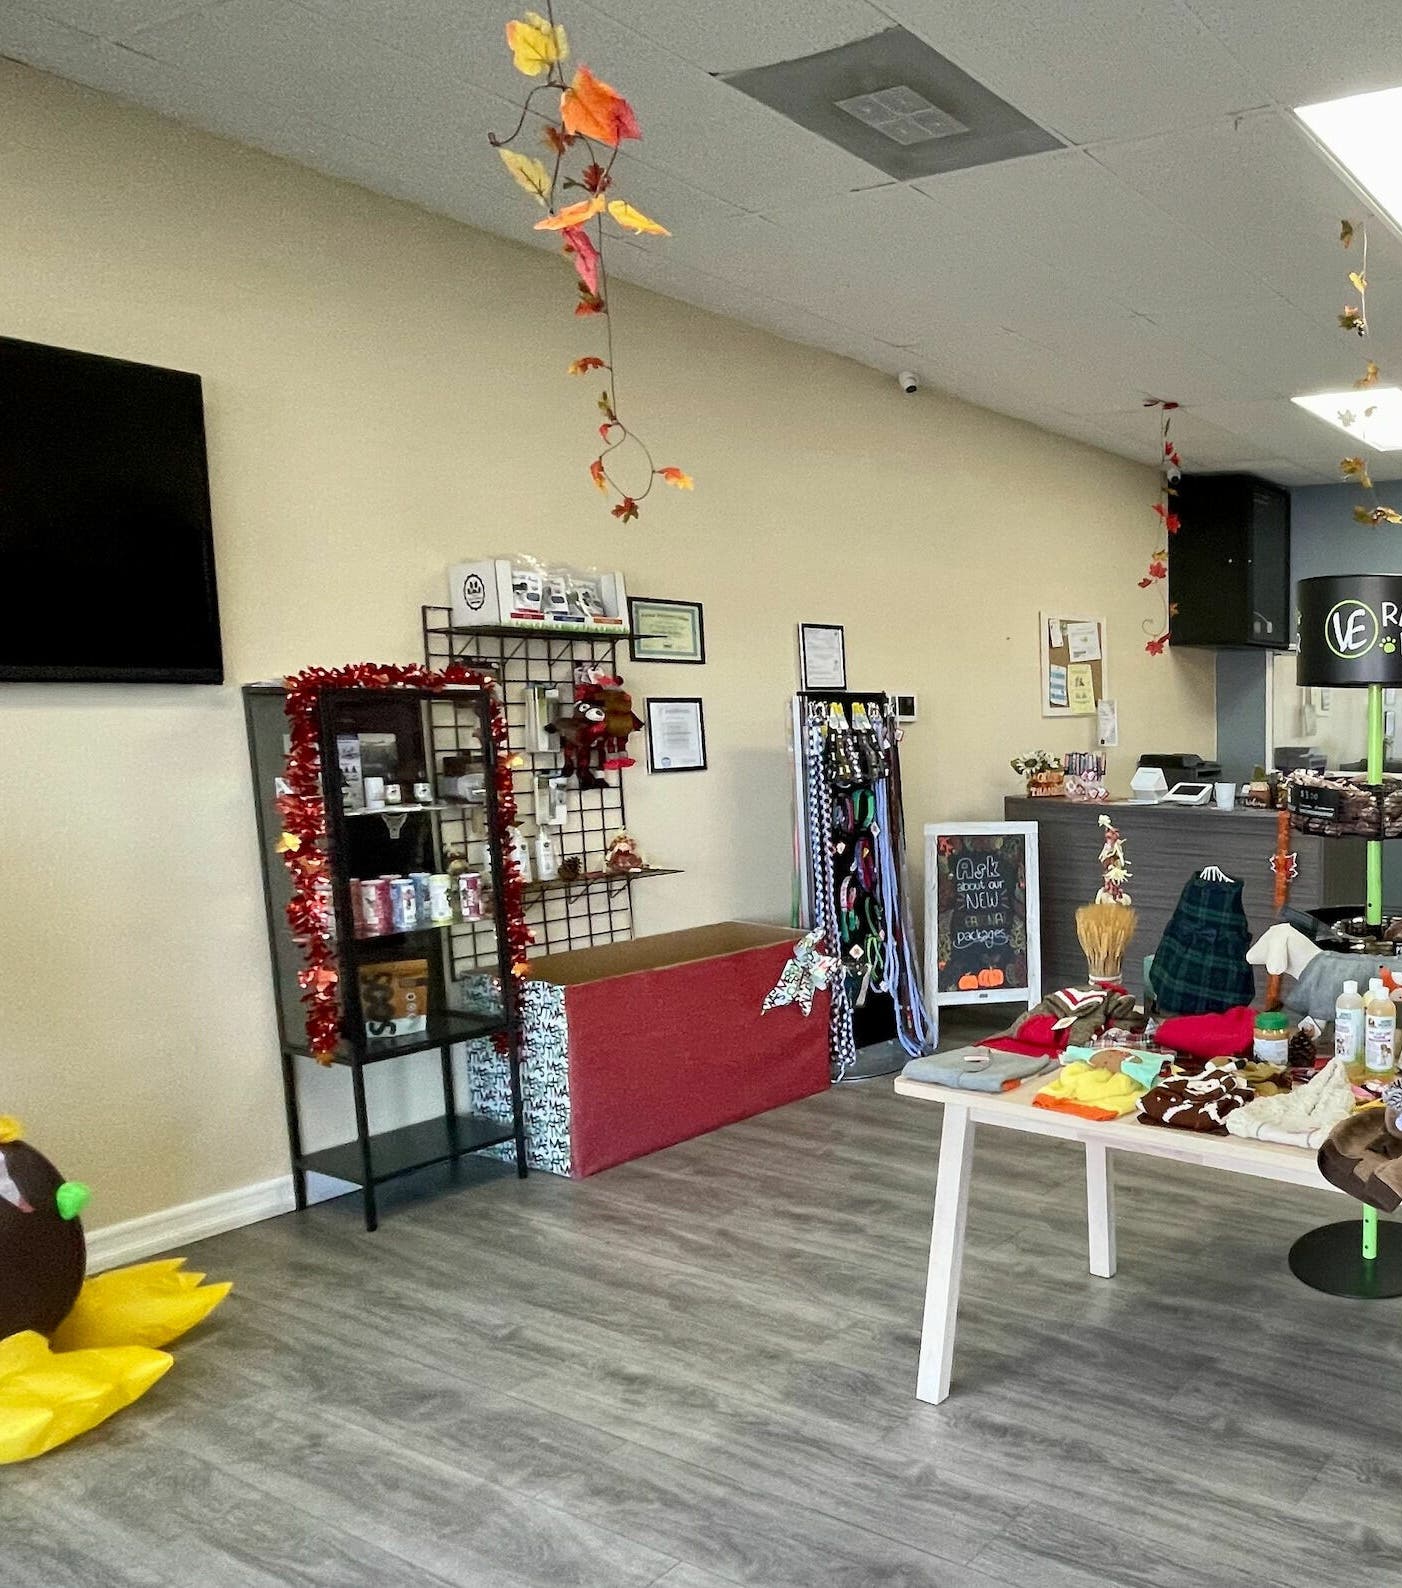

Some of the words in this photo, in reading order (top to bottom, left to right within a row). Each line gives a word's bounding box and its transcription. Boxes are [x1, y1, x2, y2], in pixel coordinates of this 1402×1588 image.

[956, 855, 1000, 880] Ask
[957, 880, 985, 892] about
[988, 880, 1004, 890] our
[966, 892, 999, 910] NEW
